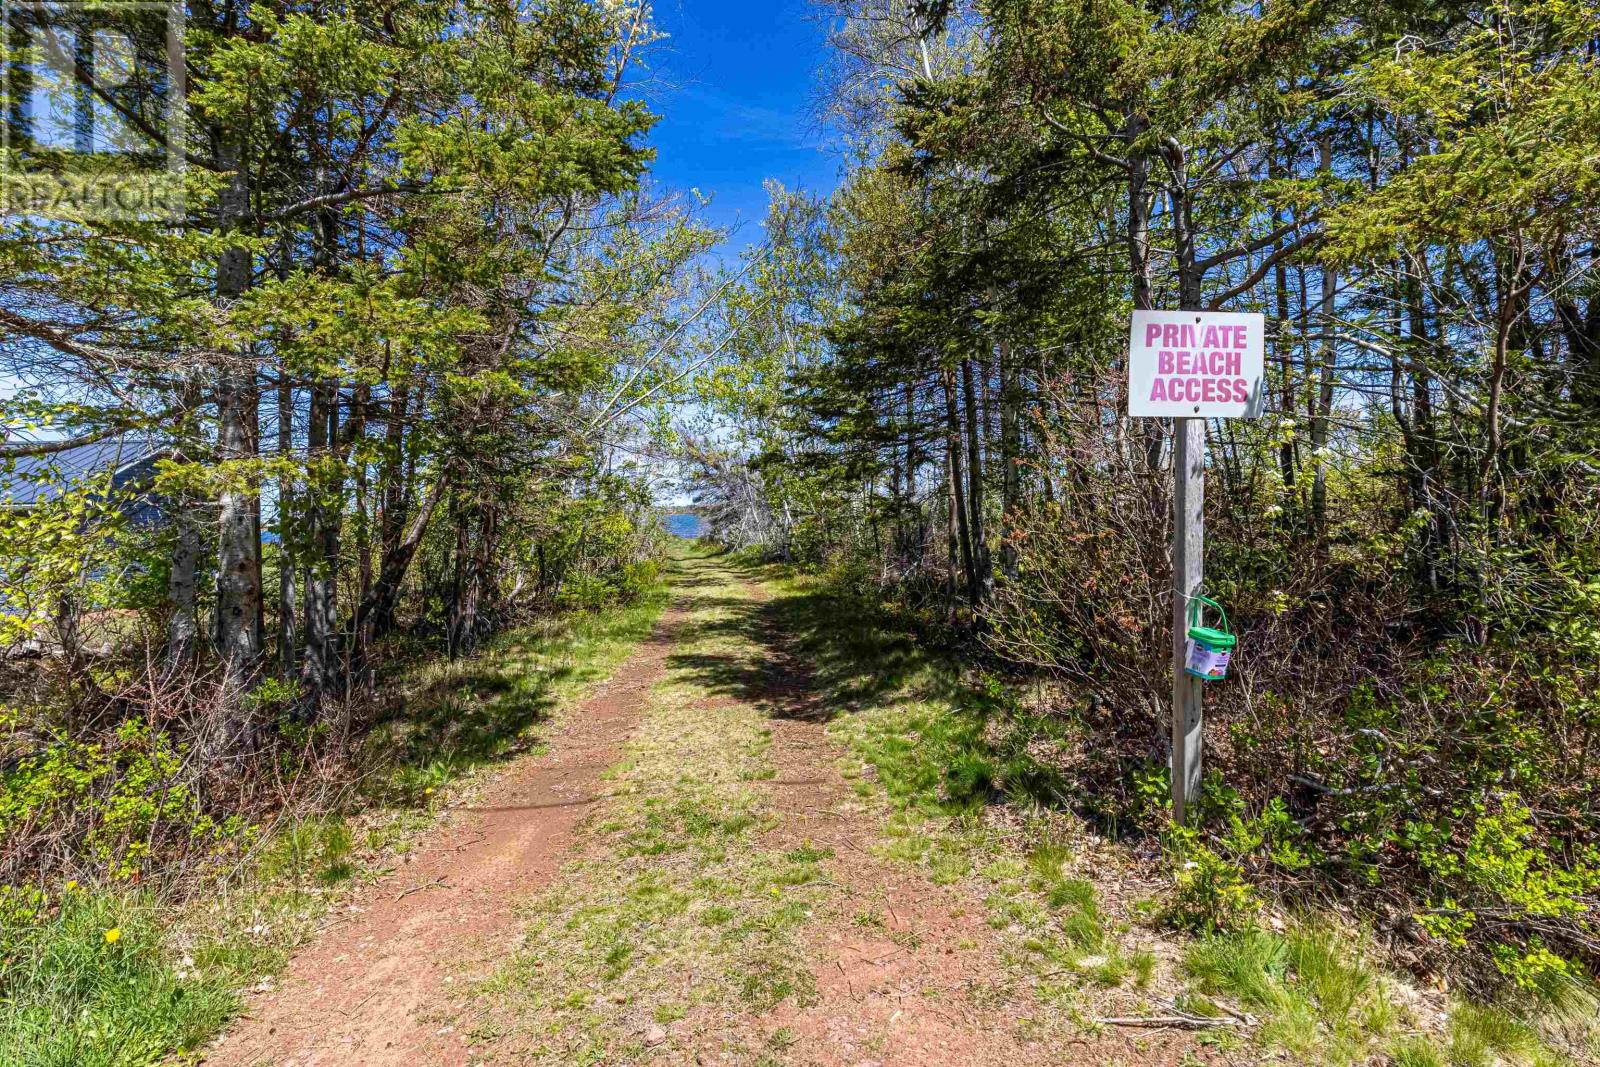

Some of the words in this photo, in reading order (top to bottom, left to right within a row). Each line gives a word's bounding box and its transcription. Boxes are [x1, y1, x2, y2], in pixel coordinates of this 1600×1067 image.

[1146, 324, 1248, 349] PRIVATE
[1158, 351, 1242, 375] BEACH
[1150, 378, 1248, 402] ACCESS
